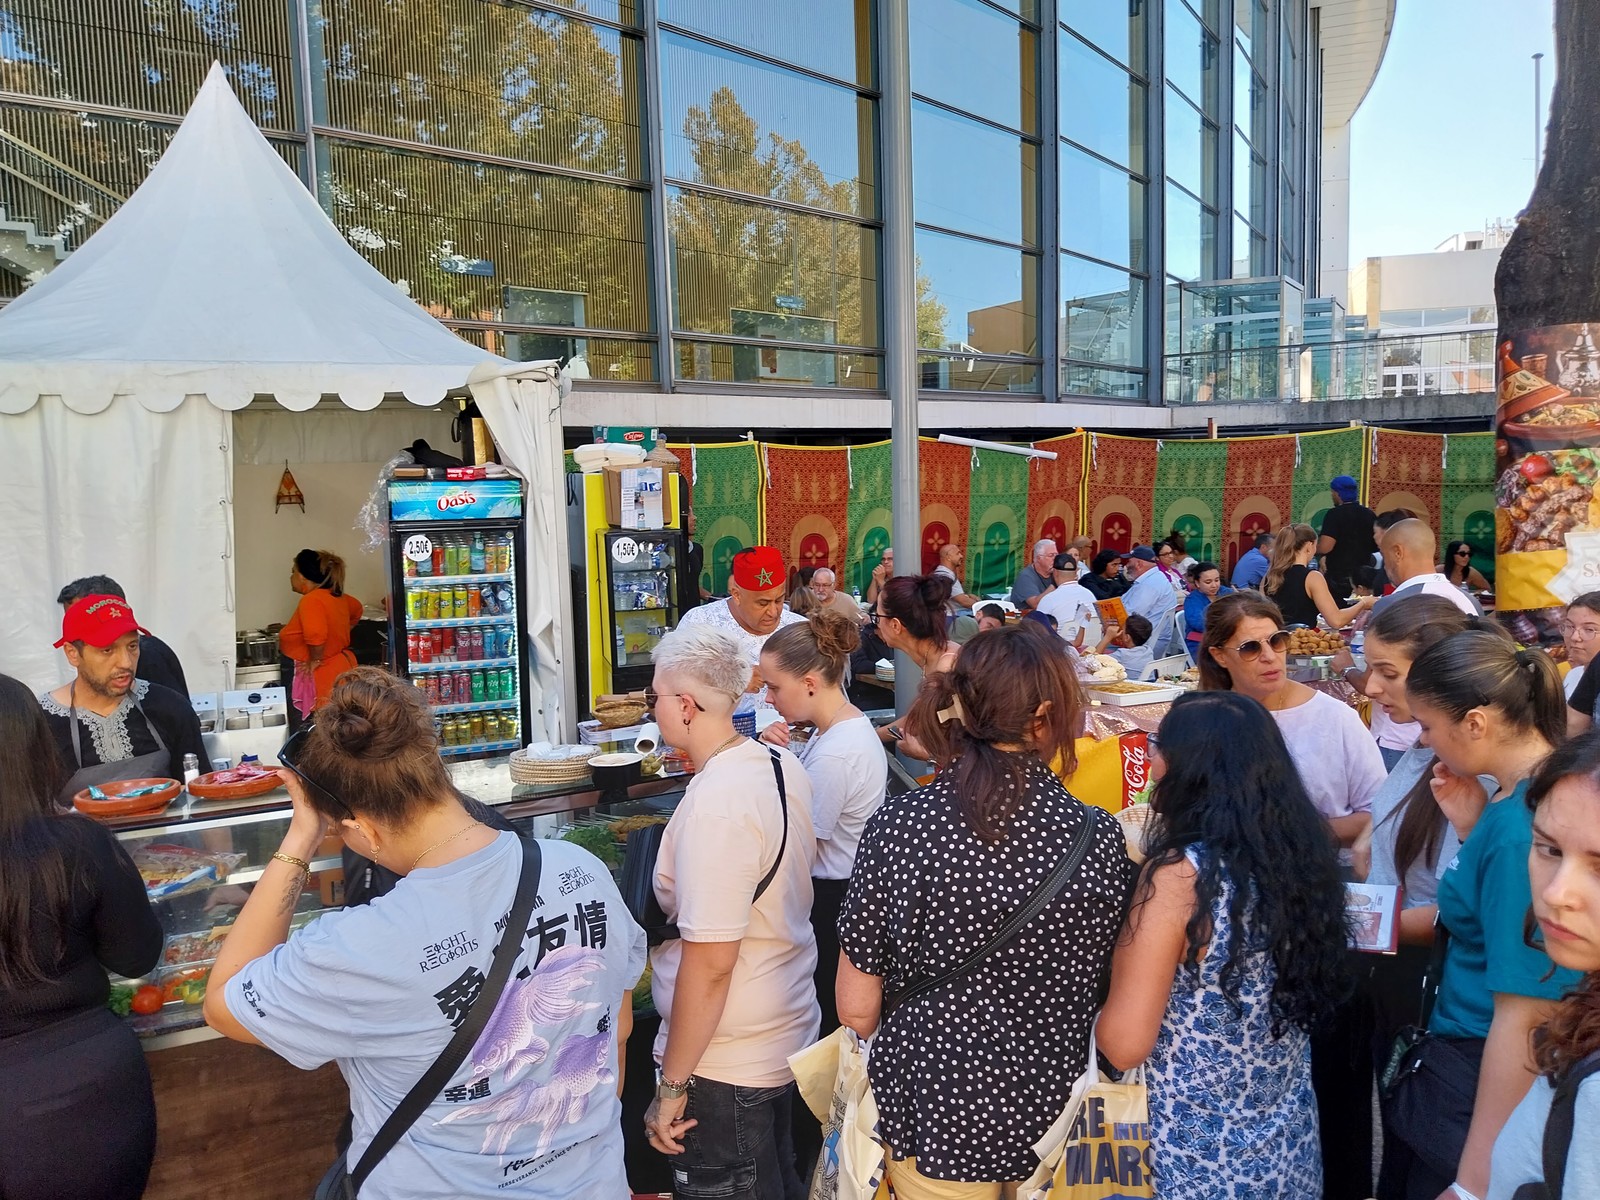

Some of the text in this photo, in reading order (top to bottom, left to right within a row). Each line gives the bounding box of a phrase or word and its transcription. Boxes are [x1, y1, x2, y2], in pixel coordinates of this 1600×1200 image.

[437, 490, 476, 511] Oasis
[408, 540, 430, 557] 2,50€
[616, 542, 636, 559] 1,50€
[85, 598, 131, 615] MOROCCO
[498, 1168, 539, 1189] PERSEVERANCE
[544, 1157, 555, 1166] THE
[555, 1149, 567, 1161] FACE
